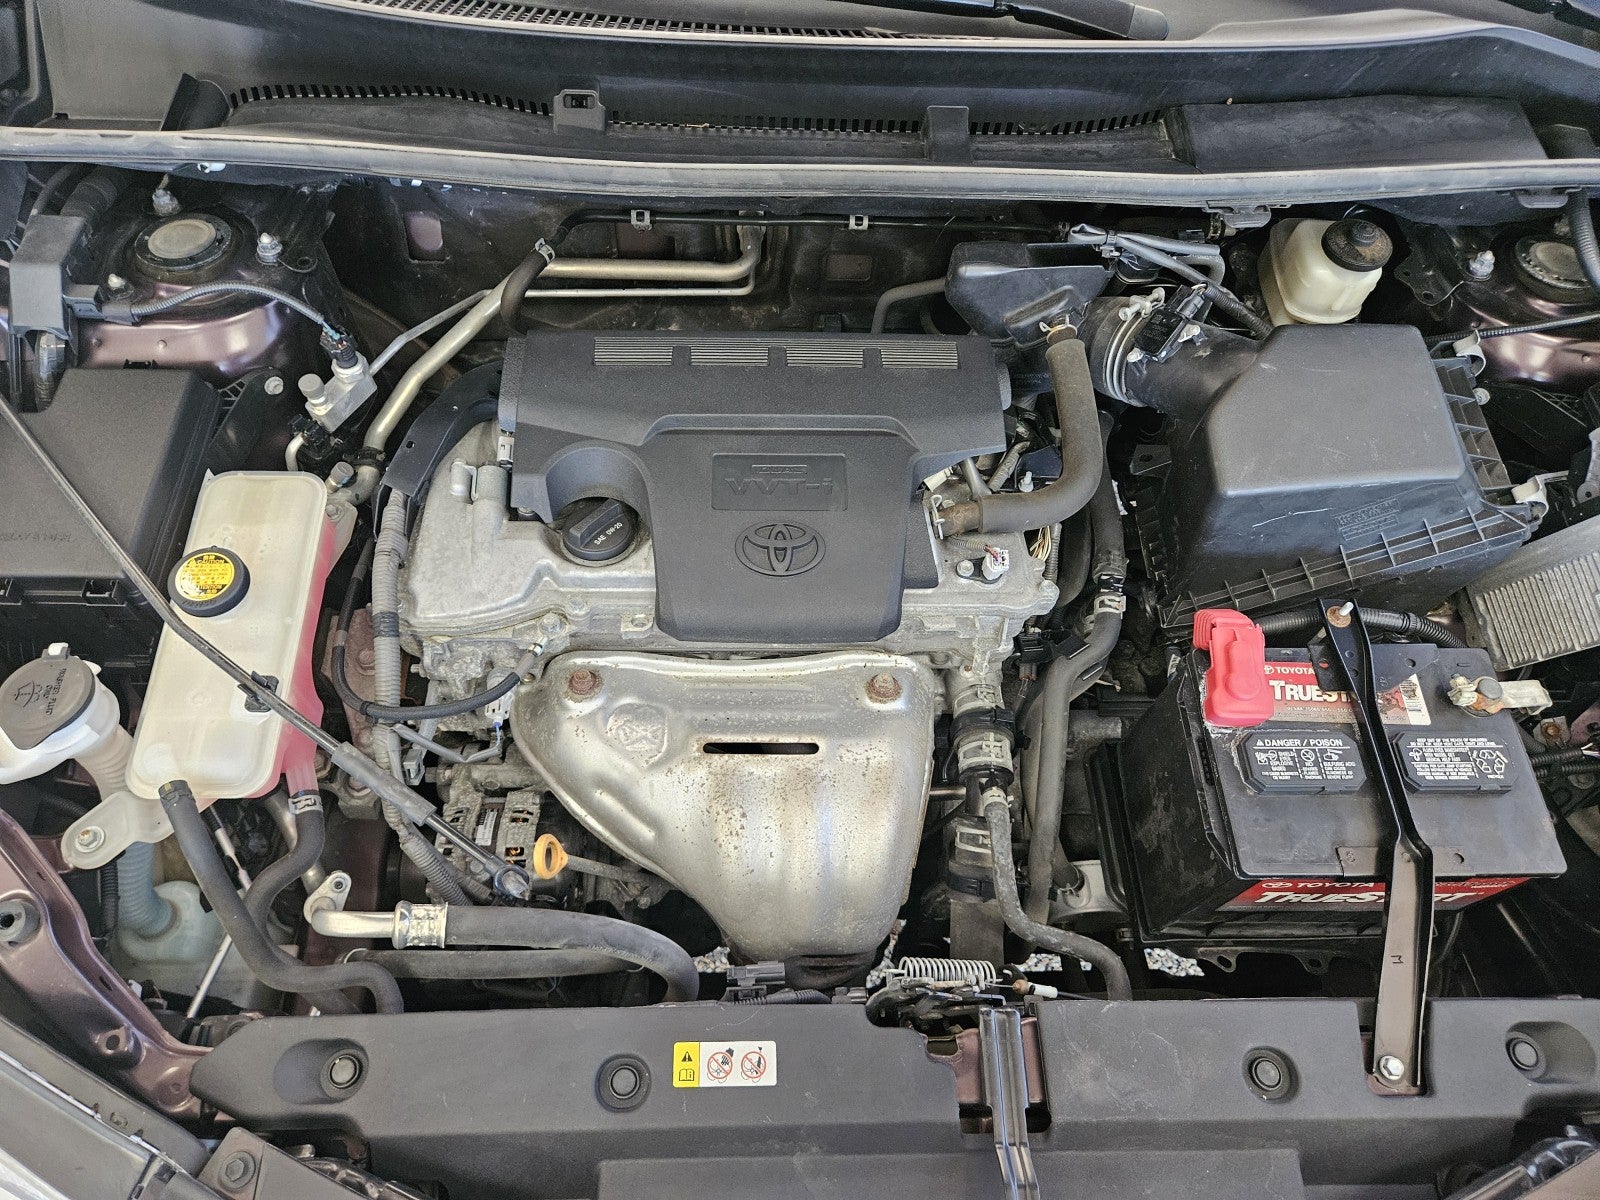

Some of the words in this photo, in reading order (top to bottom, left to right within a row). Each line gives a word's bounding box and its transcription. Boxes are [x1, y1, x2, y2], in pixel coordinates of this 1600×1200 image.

[725, 478, 834, 495] VVT-i
[594, 534, 607, 545] SAE
[606, 522, 623, 535] 0W-20
[1275, 666, 1315, 675] TOYOTA
